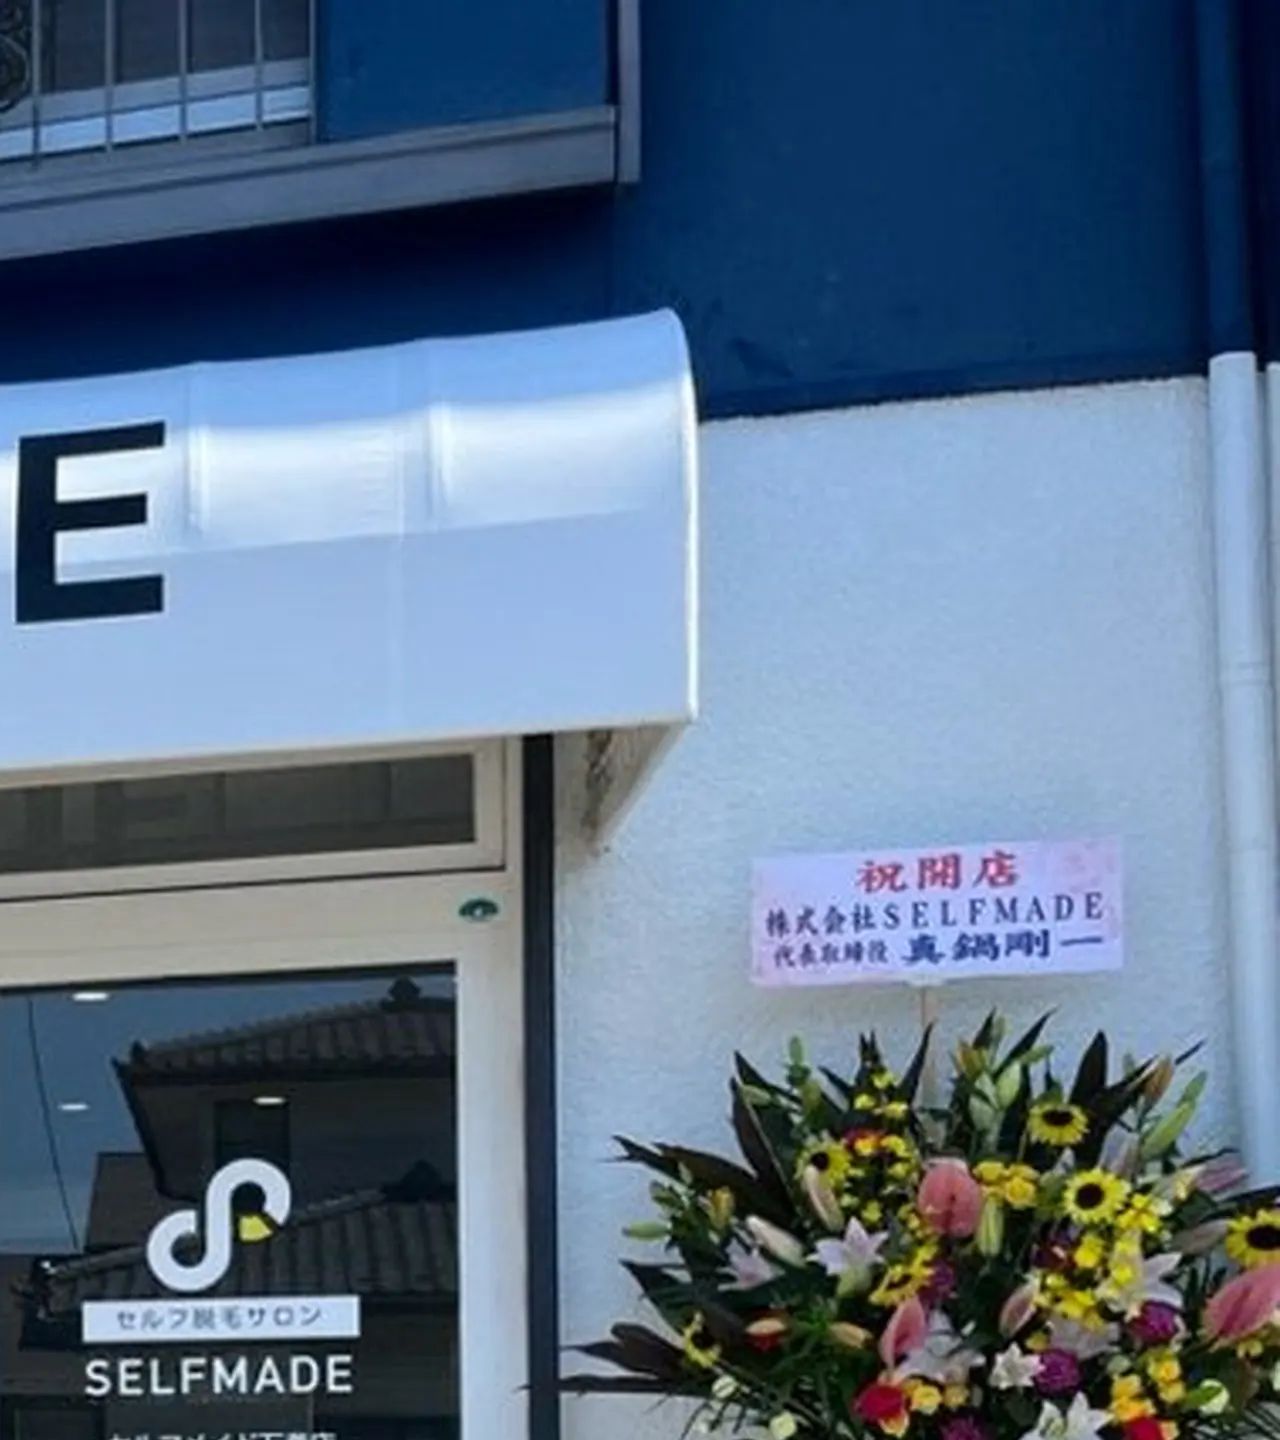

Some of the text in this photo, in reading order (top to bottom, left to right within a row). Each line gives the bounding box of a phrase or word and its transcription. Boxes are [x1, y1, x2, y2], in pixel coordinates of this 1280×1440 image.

[855, 849, 1022, 894] 祝開店
[116, 1306, 323, 1331] セルフ脱毛サロン
[84, 1354, 354, 1396] SELFMADE
